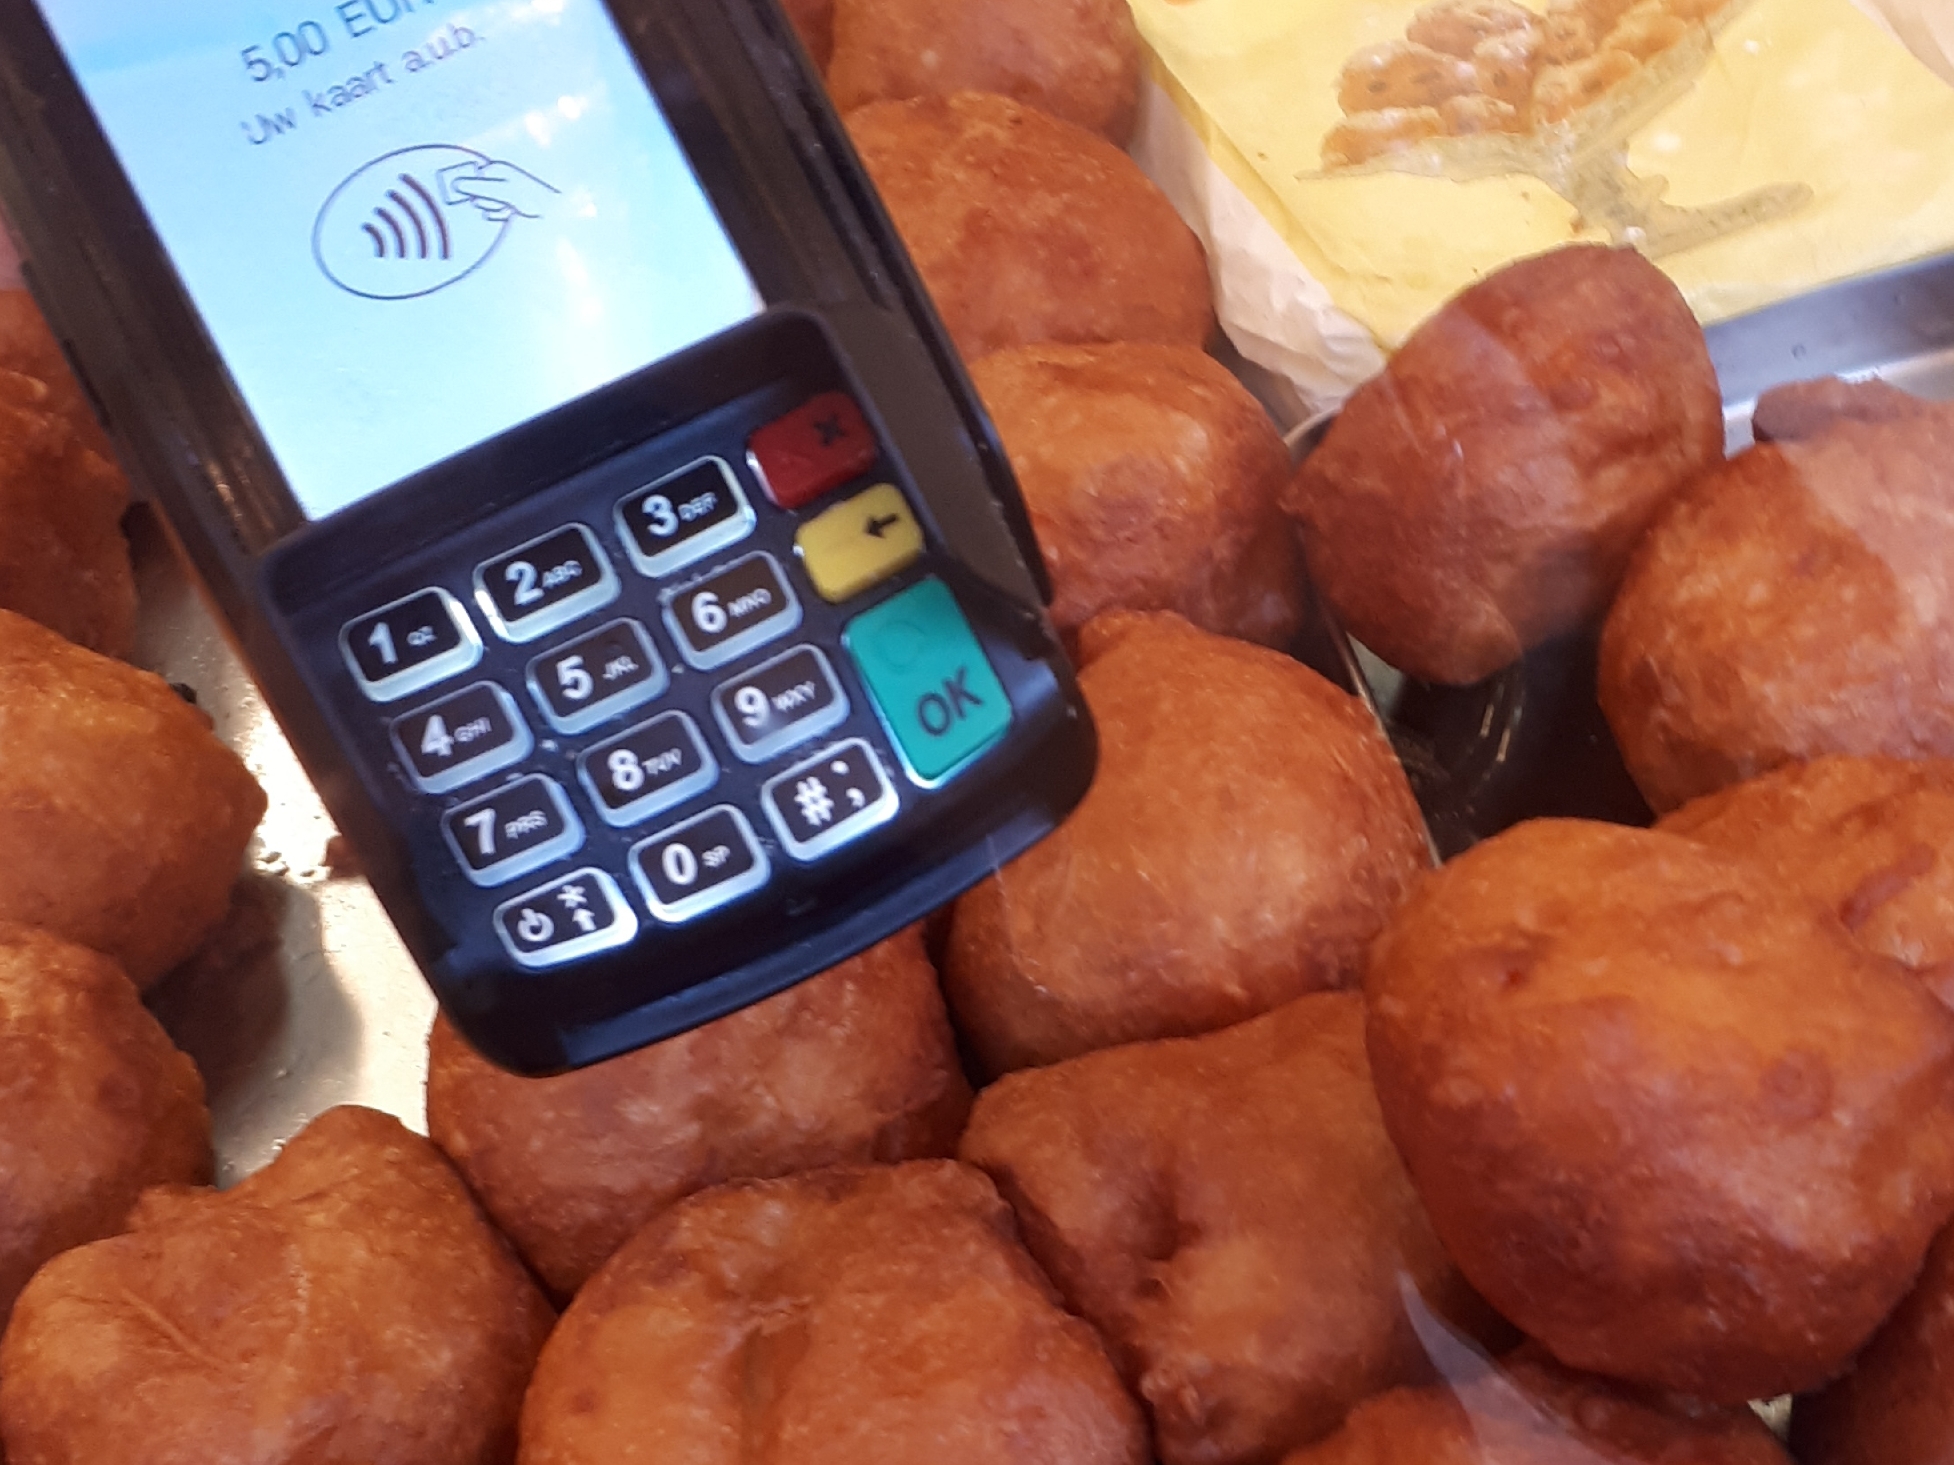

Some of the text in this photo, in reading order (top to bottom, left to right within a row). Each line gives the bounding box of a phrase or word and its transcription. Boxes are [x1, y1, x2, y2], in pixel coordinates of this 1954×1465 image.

[241, 20, 329, 82] 5,00
[240, 107, 297, 145] Uw
[302, 61, 397, 117] kaart
[642, 494, 679, 537] 3
[505, 560, 545, 606] 2
[691, 591, 728, 634] 6
[367, 621, 398, 665] 1
[555, 655, 594, 700] 5
[733, 686, 770, 728] 9
[917, 666, 984, 737] OK
[420, 714, 455, 757] 4
[607, 749, 645, 791] 8
[463, 808, 497, 855] 7
[661, 842, 699, 885] 0
